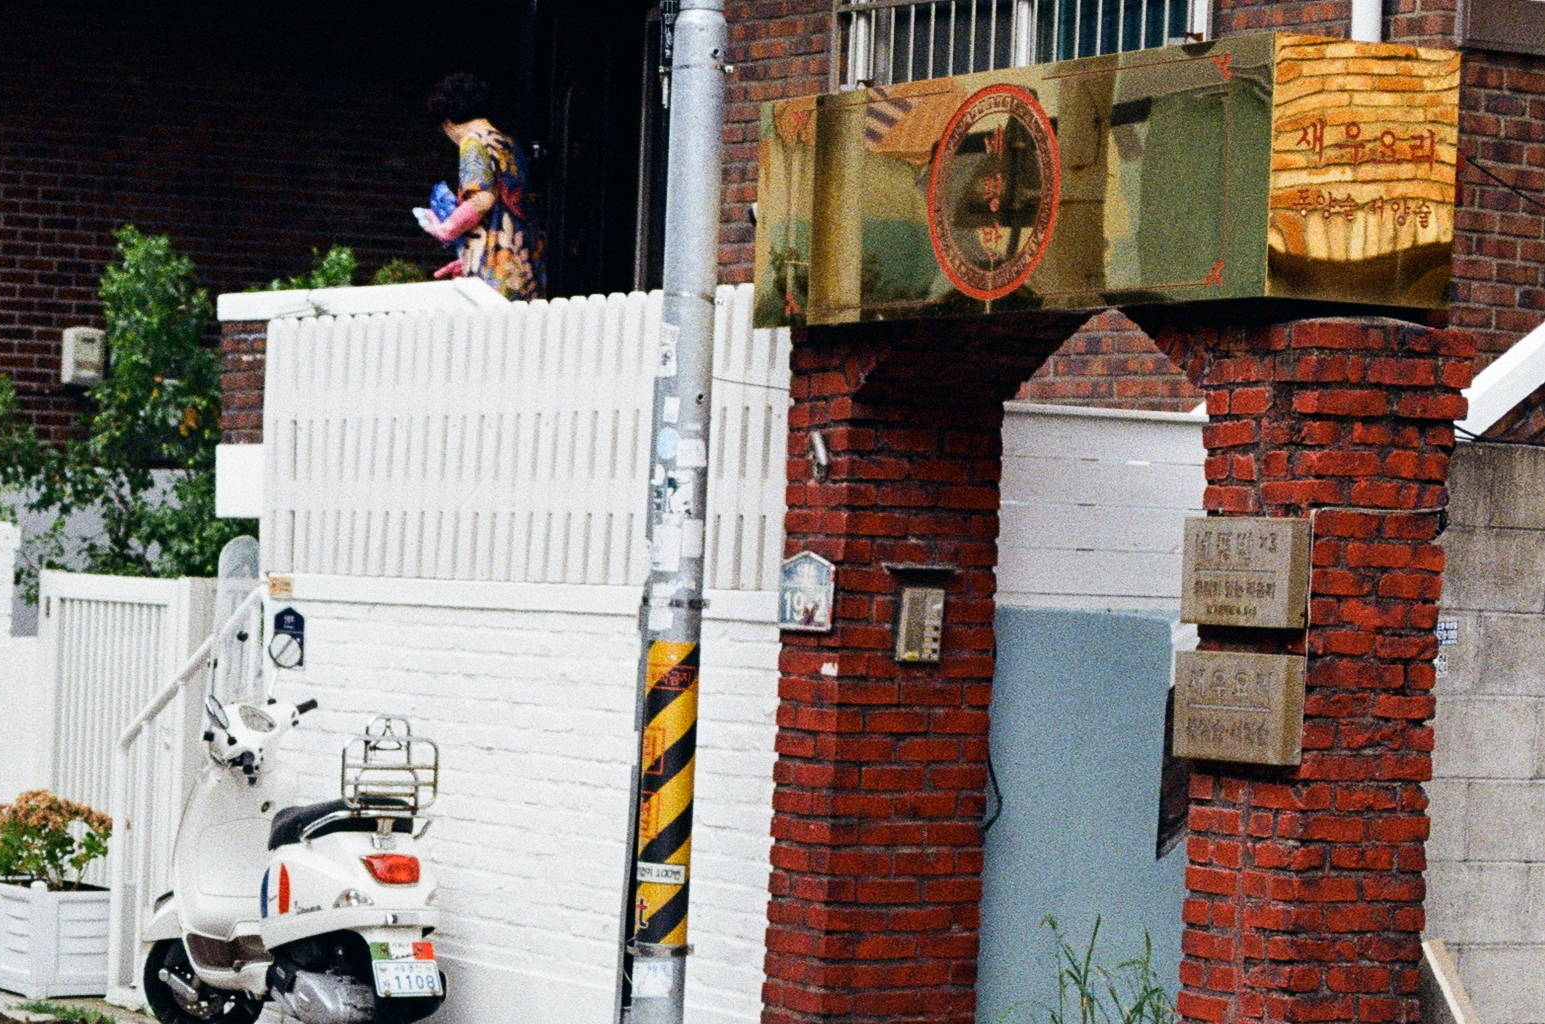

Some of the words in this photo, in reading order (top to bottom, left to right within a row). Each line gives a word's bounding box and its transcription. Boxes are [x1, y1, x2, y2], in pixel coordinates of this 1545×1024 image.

[1295, 117, 1436, 173] 새우요리
[981, 124, 1005, 260] 네평반
[394, 974, 437, 990] 1108
